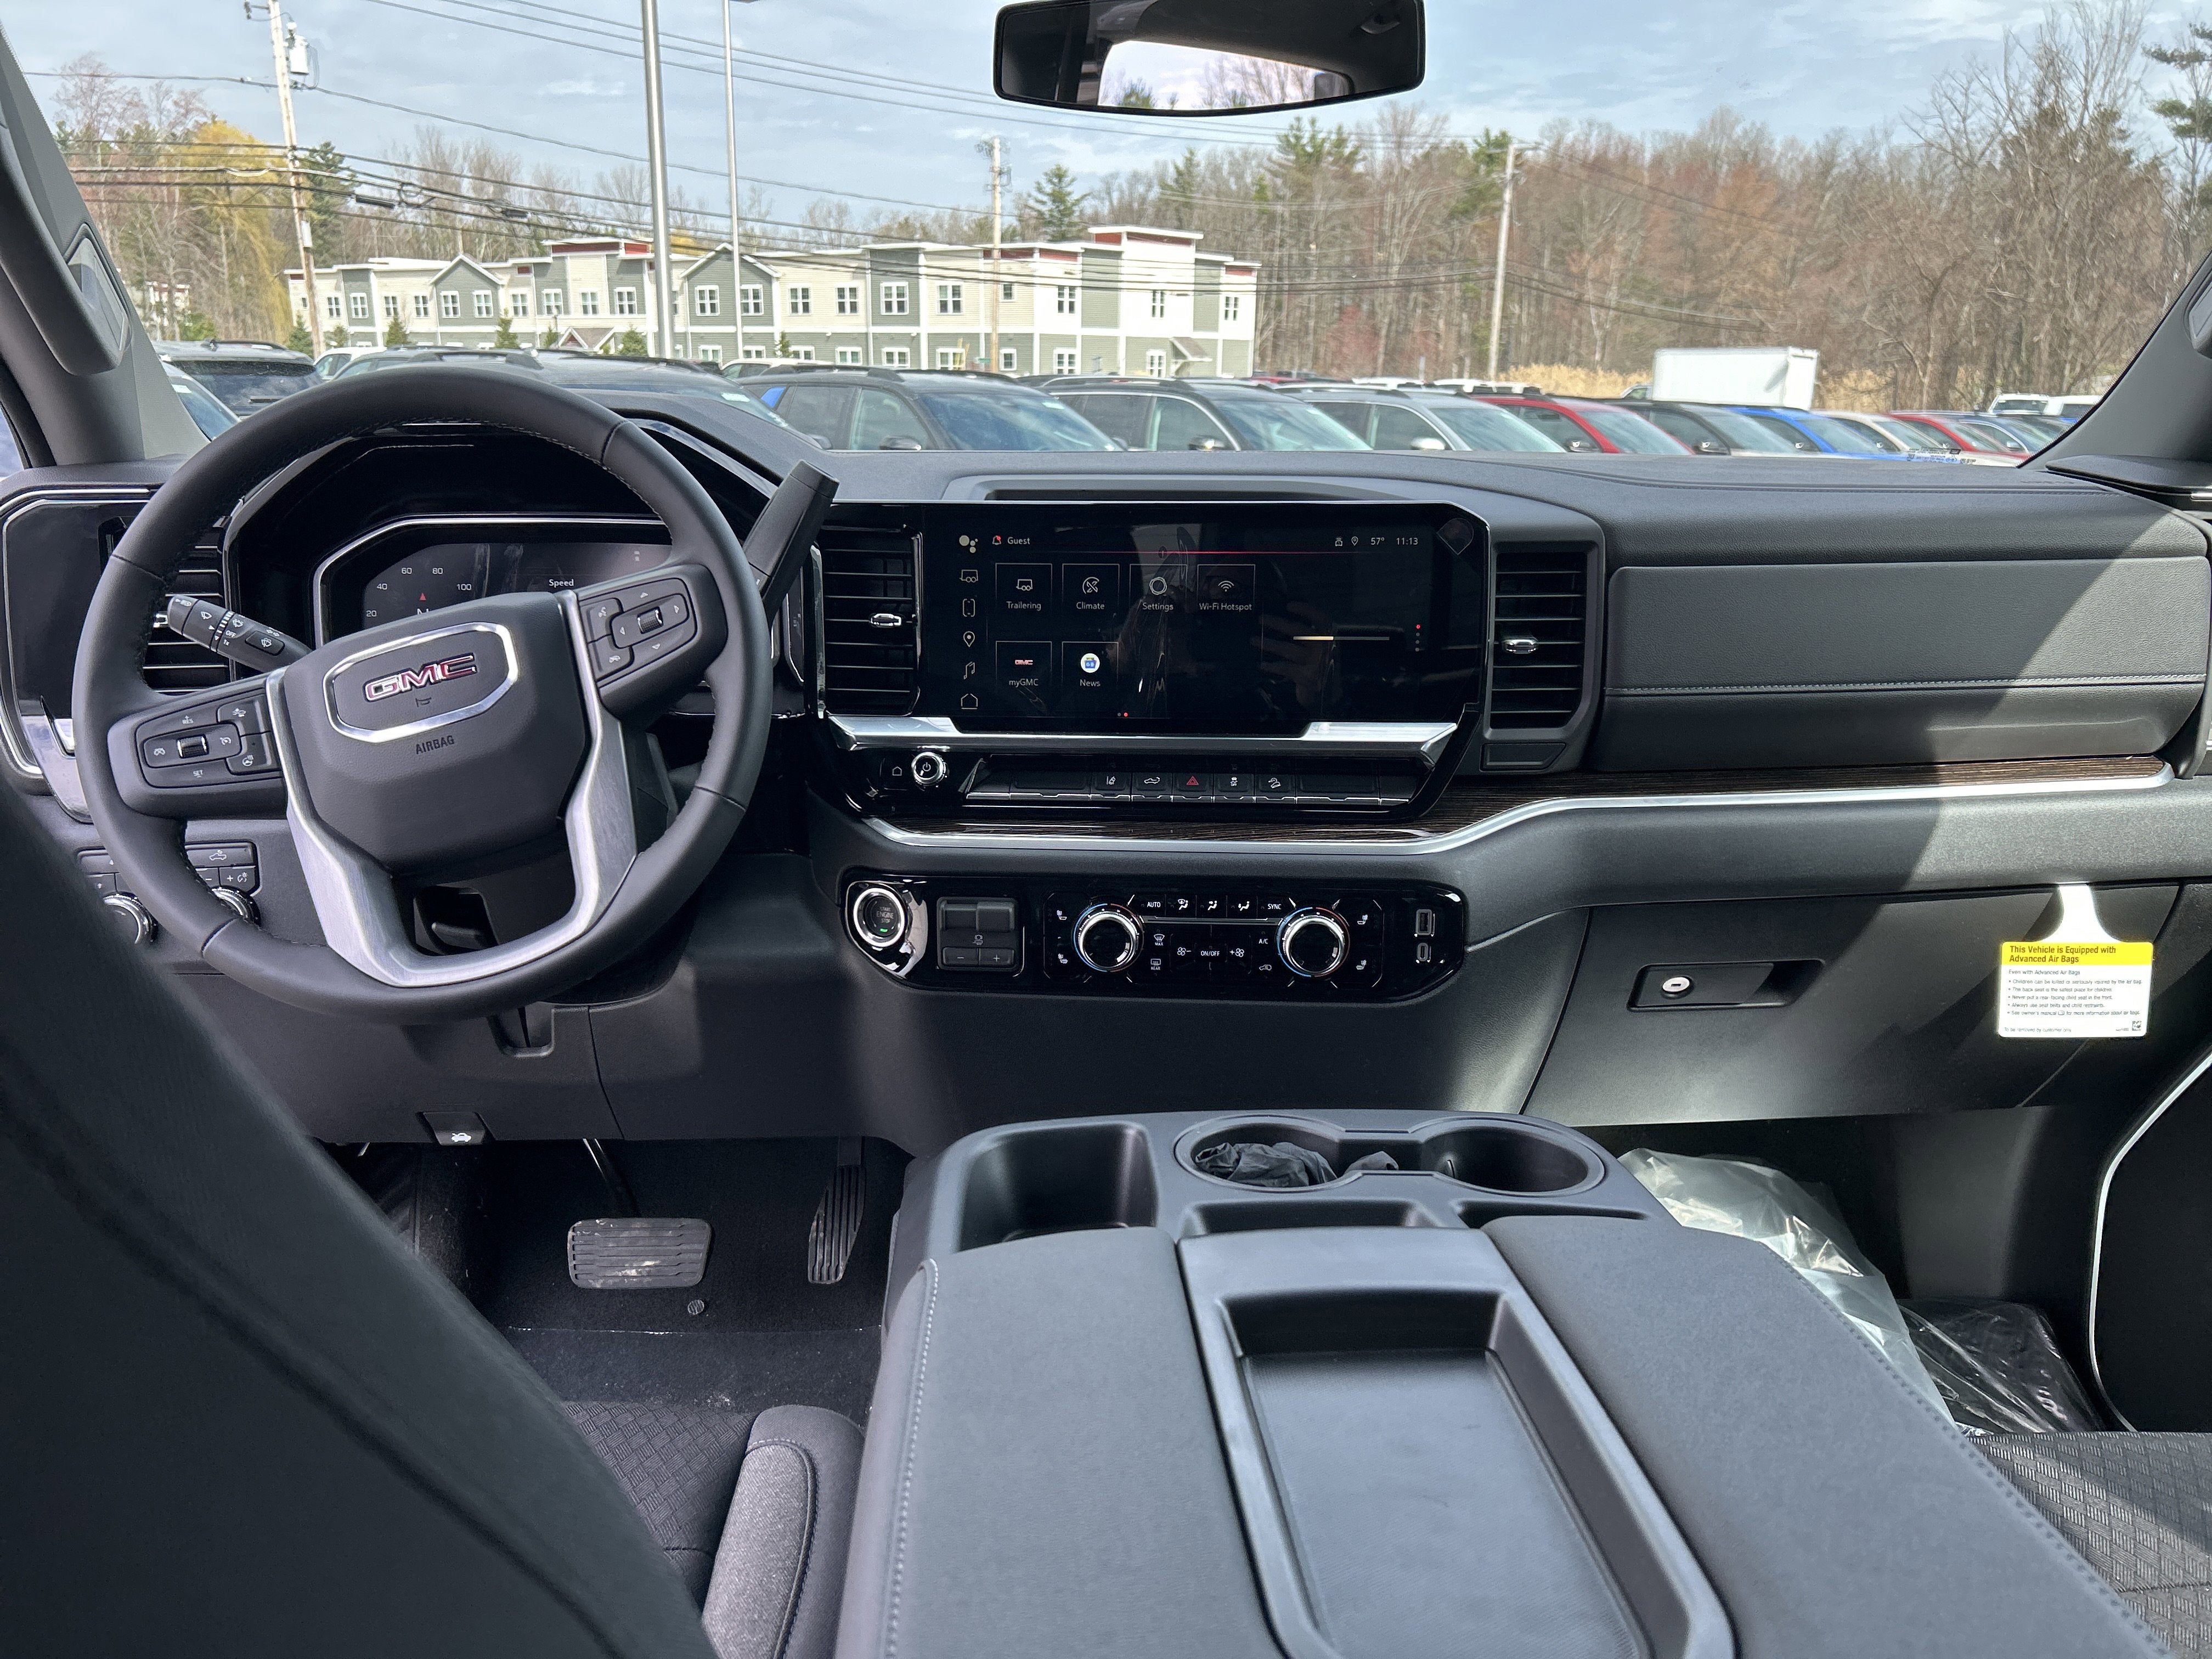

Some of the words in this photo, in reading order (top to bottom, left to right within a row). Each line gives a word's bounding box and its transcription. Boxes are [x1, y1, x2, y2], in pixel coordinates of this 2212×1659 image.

[1370, 537, 1385, 545] 57°
[1396, 537, 1418, 545] 11:13
[549, 579, 574, 588] Speed
[1006, 601, 1041, 611] Trailering
[1142, 602, 1173, 612] Settings
[1221, 603, 1252, 612] Hotspot
[364, 653, 477, 701] GMC
[1009, 679, 1039, 687] myGMC
[416, 735, 455, 754] AIRBAG
[2066, 946, 2098, 955] Equipped
[2061, 955, 2079, 964] Bags
